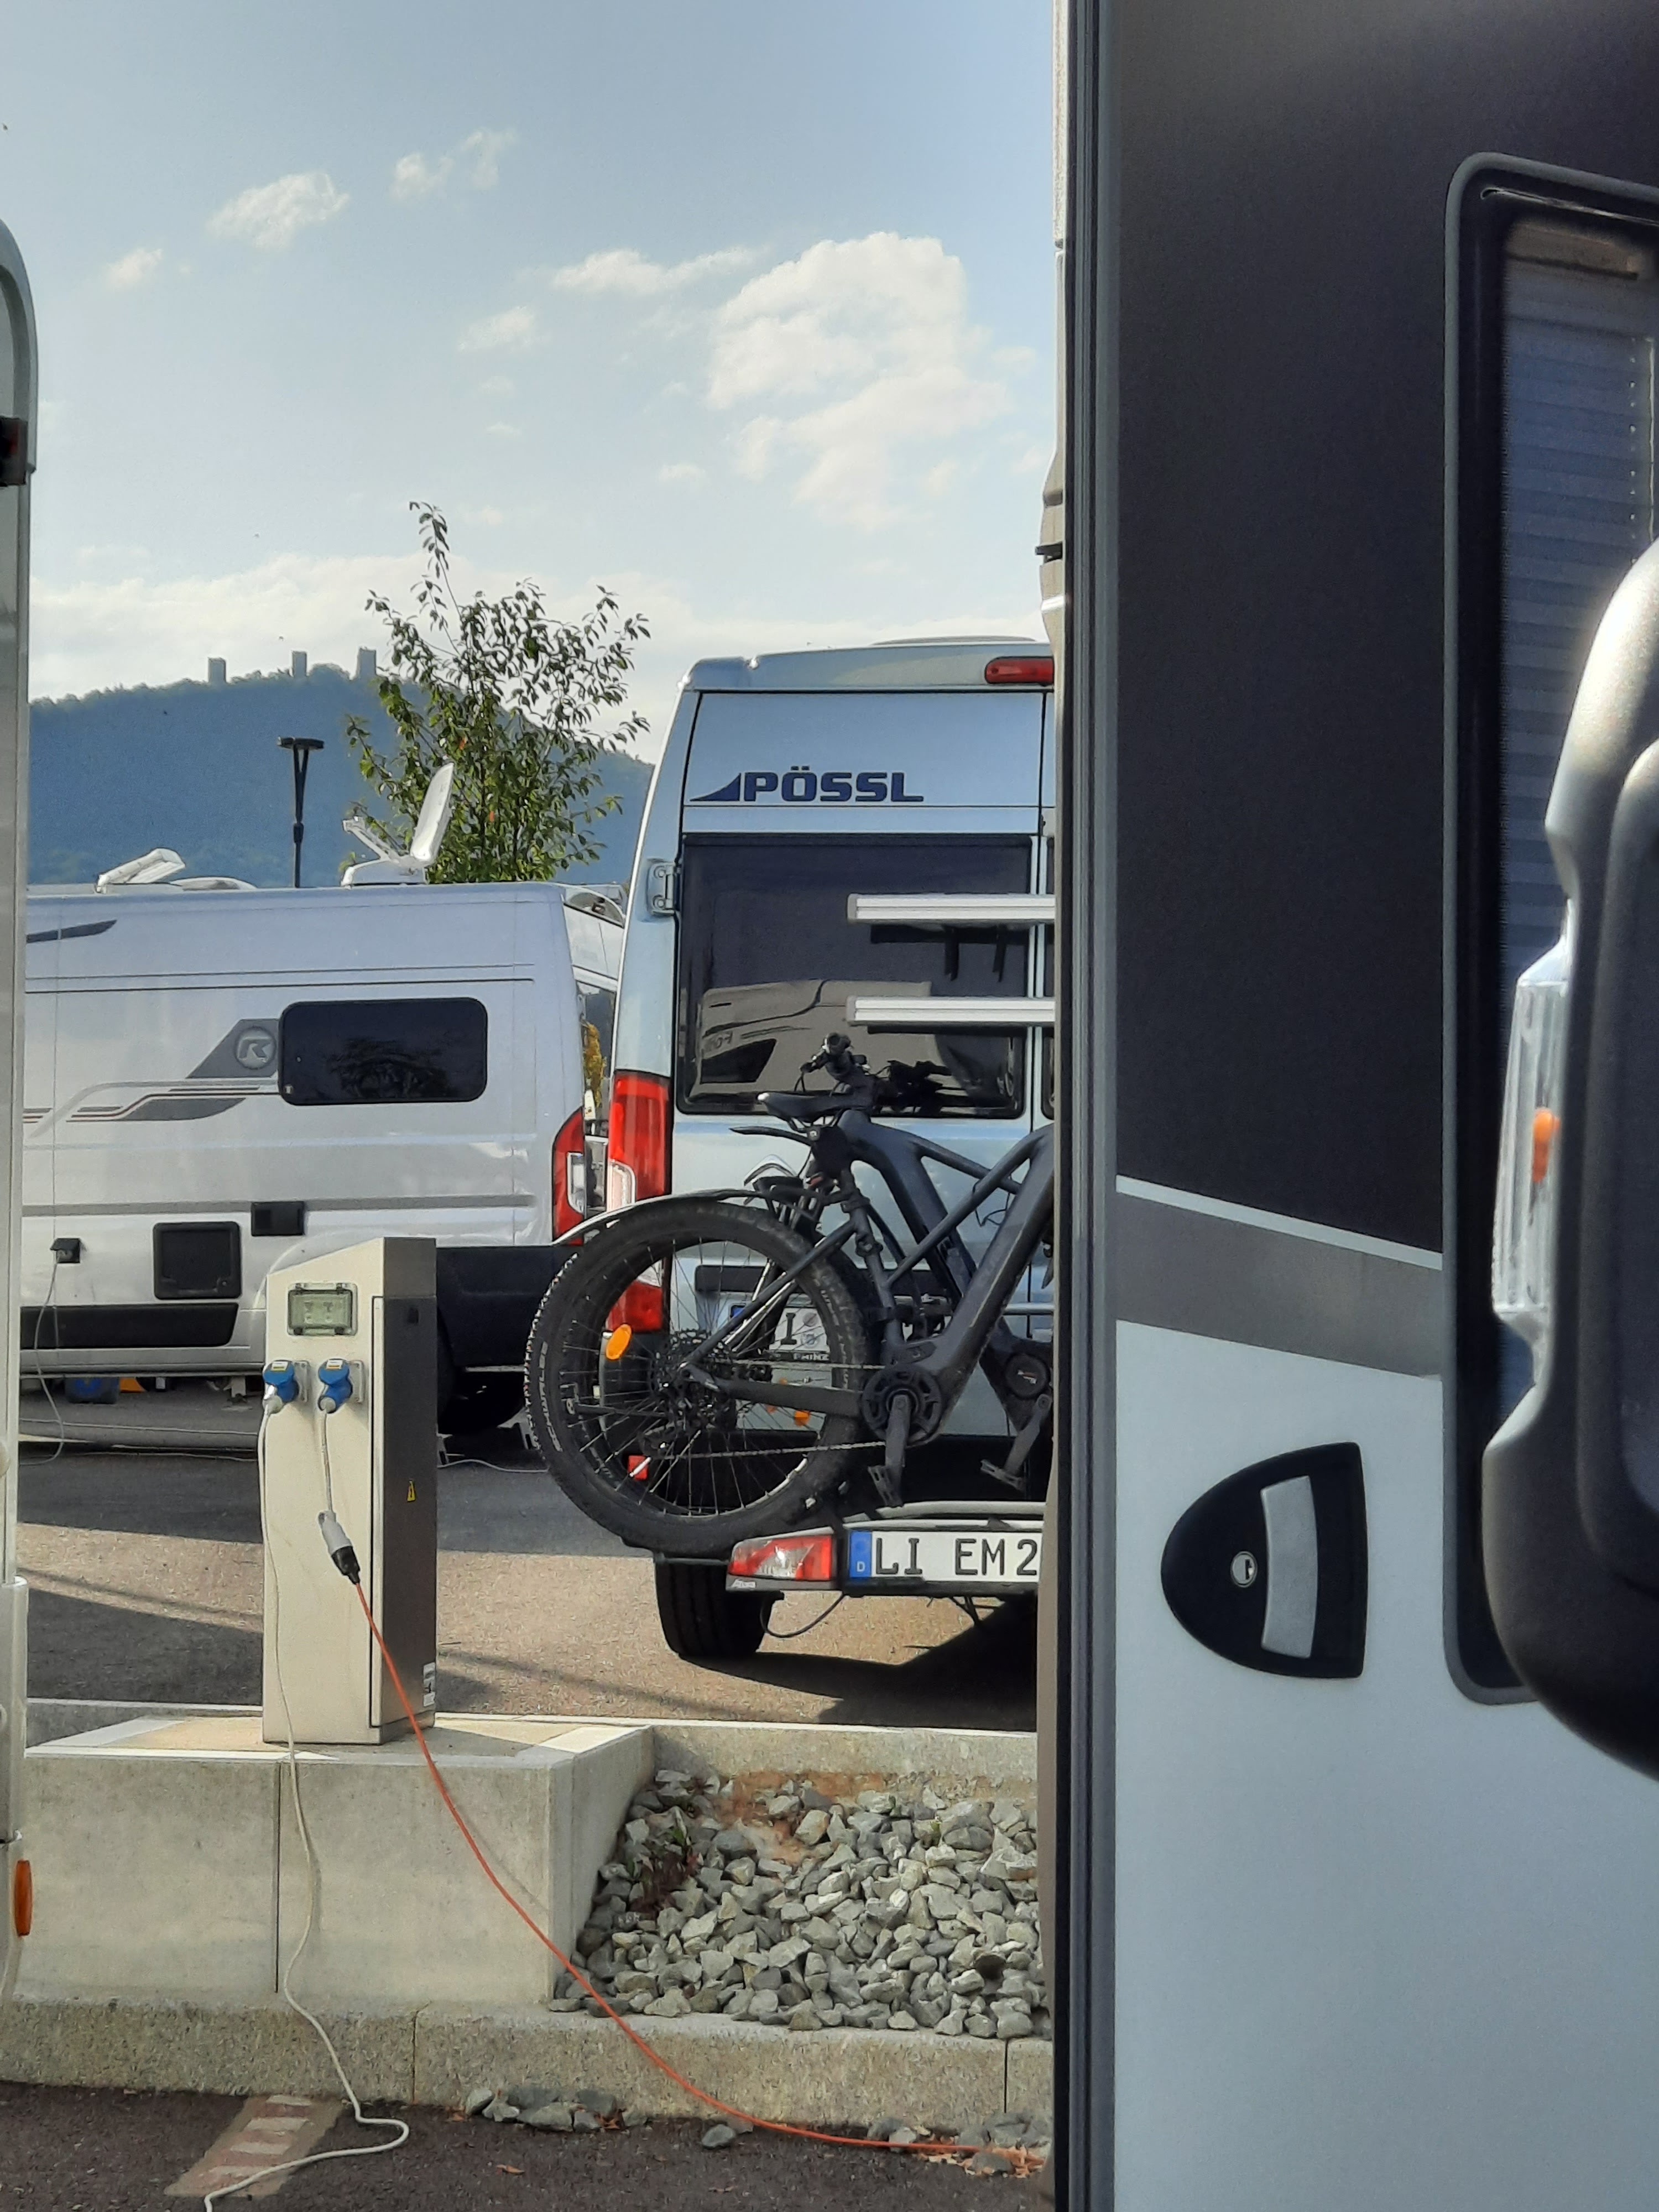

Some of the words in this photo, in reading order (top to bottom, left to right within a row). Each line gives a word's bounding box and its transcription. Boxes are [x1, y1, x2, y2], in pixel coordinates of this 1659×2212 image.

[744, 766, 924, 802] PÖSSL
[780, 1312, 797, 1345] I
[857, 1561, 865, 1572] D
[875, 1537, 922, 1575] LI
